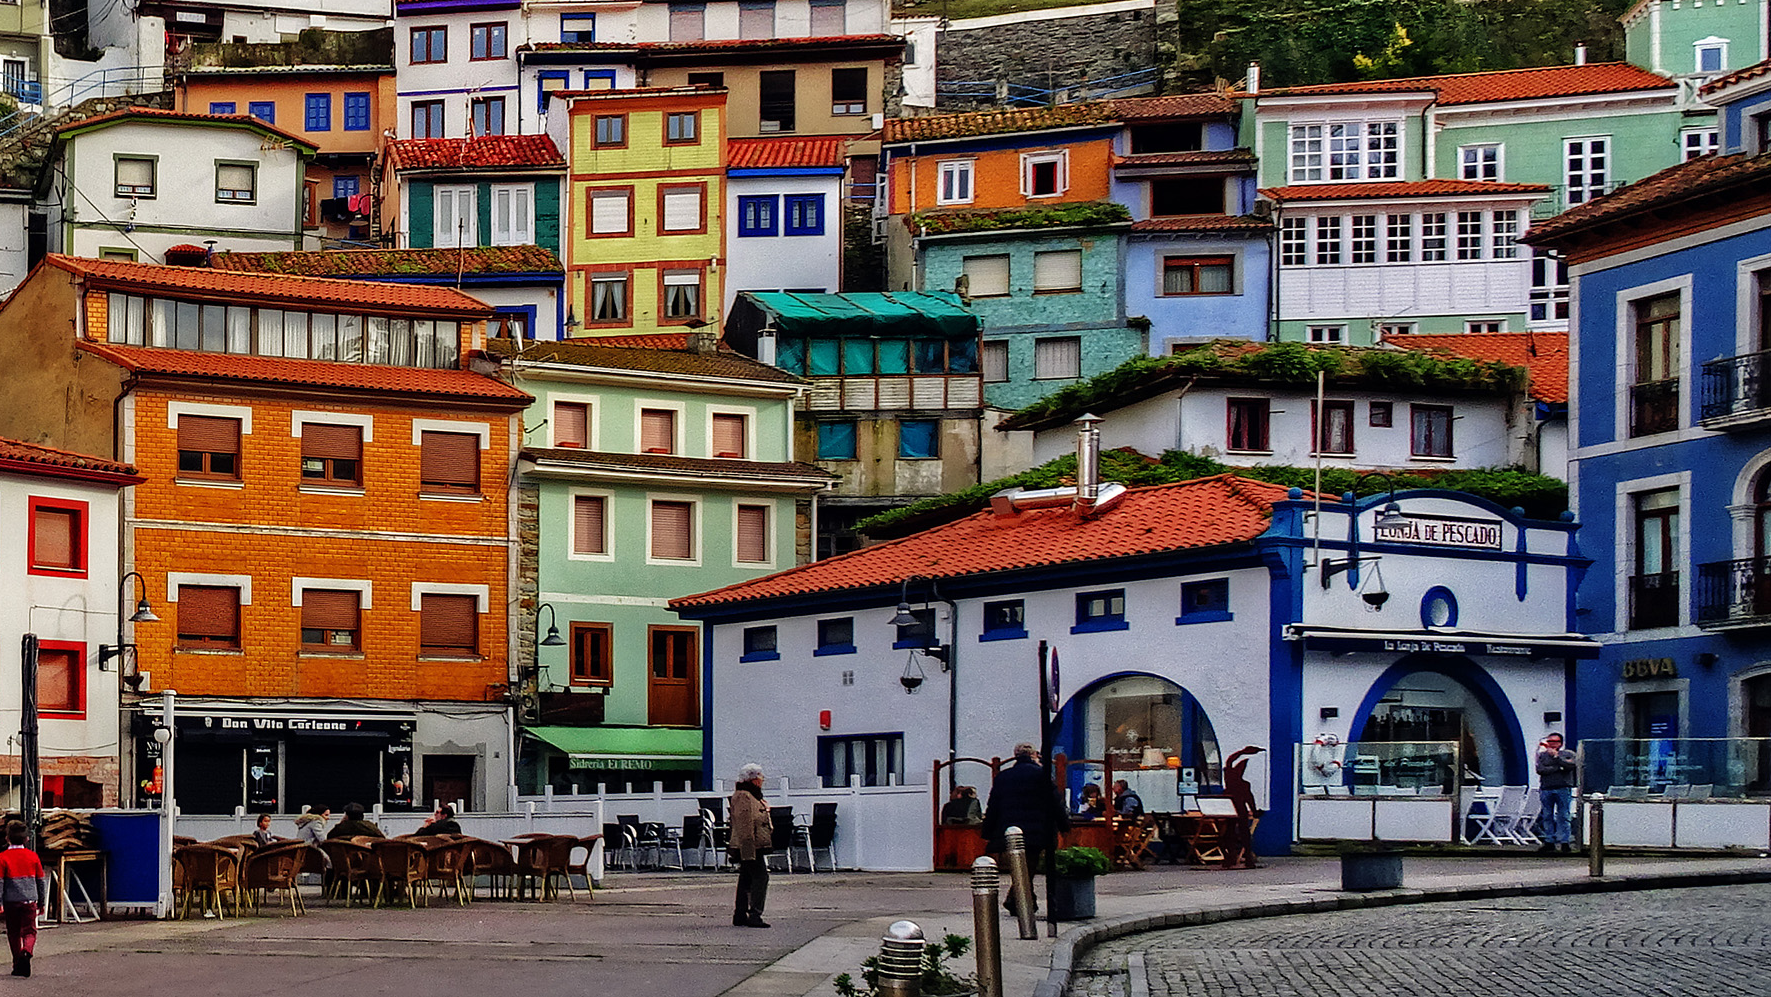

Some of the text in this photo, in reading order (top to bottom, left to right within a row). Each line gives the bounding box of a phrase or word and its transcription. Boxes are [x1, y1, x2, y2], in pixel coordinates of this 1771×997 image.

[1424, 524, 1439, 541] DE
[1441, 523, 1498, 545] PESCADO
[222, 717, 347, 731] Don Vito Corleone
